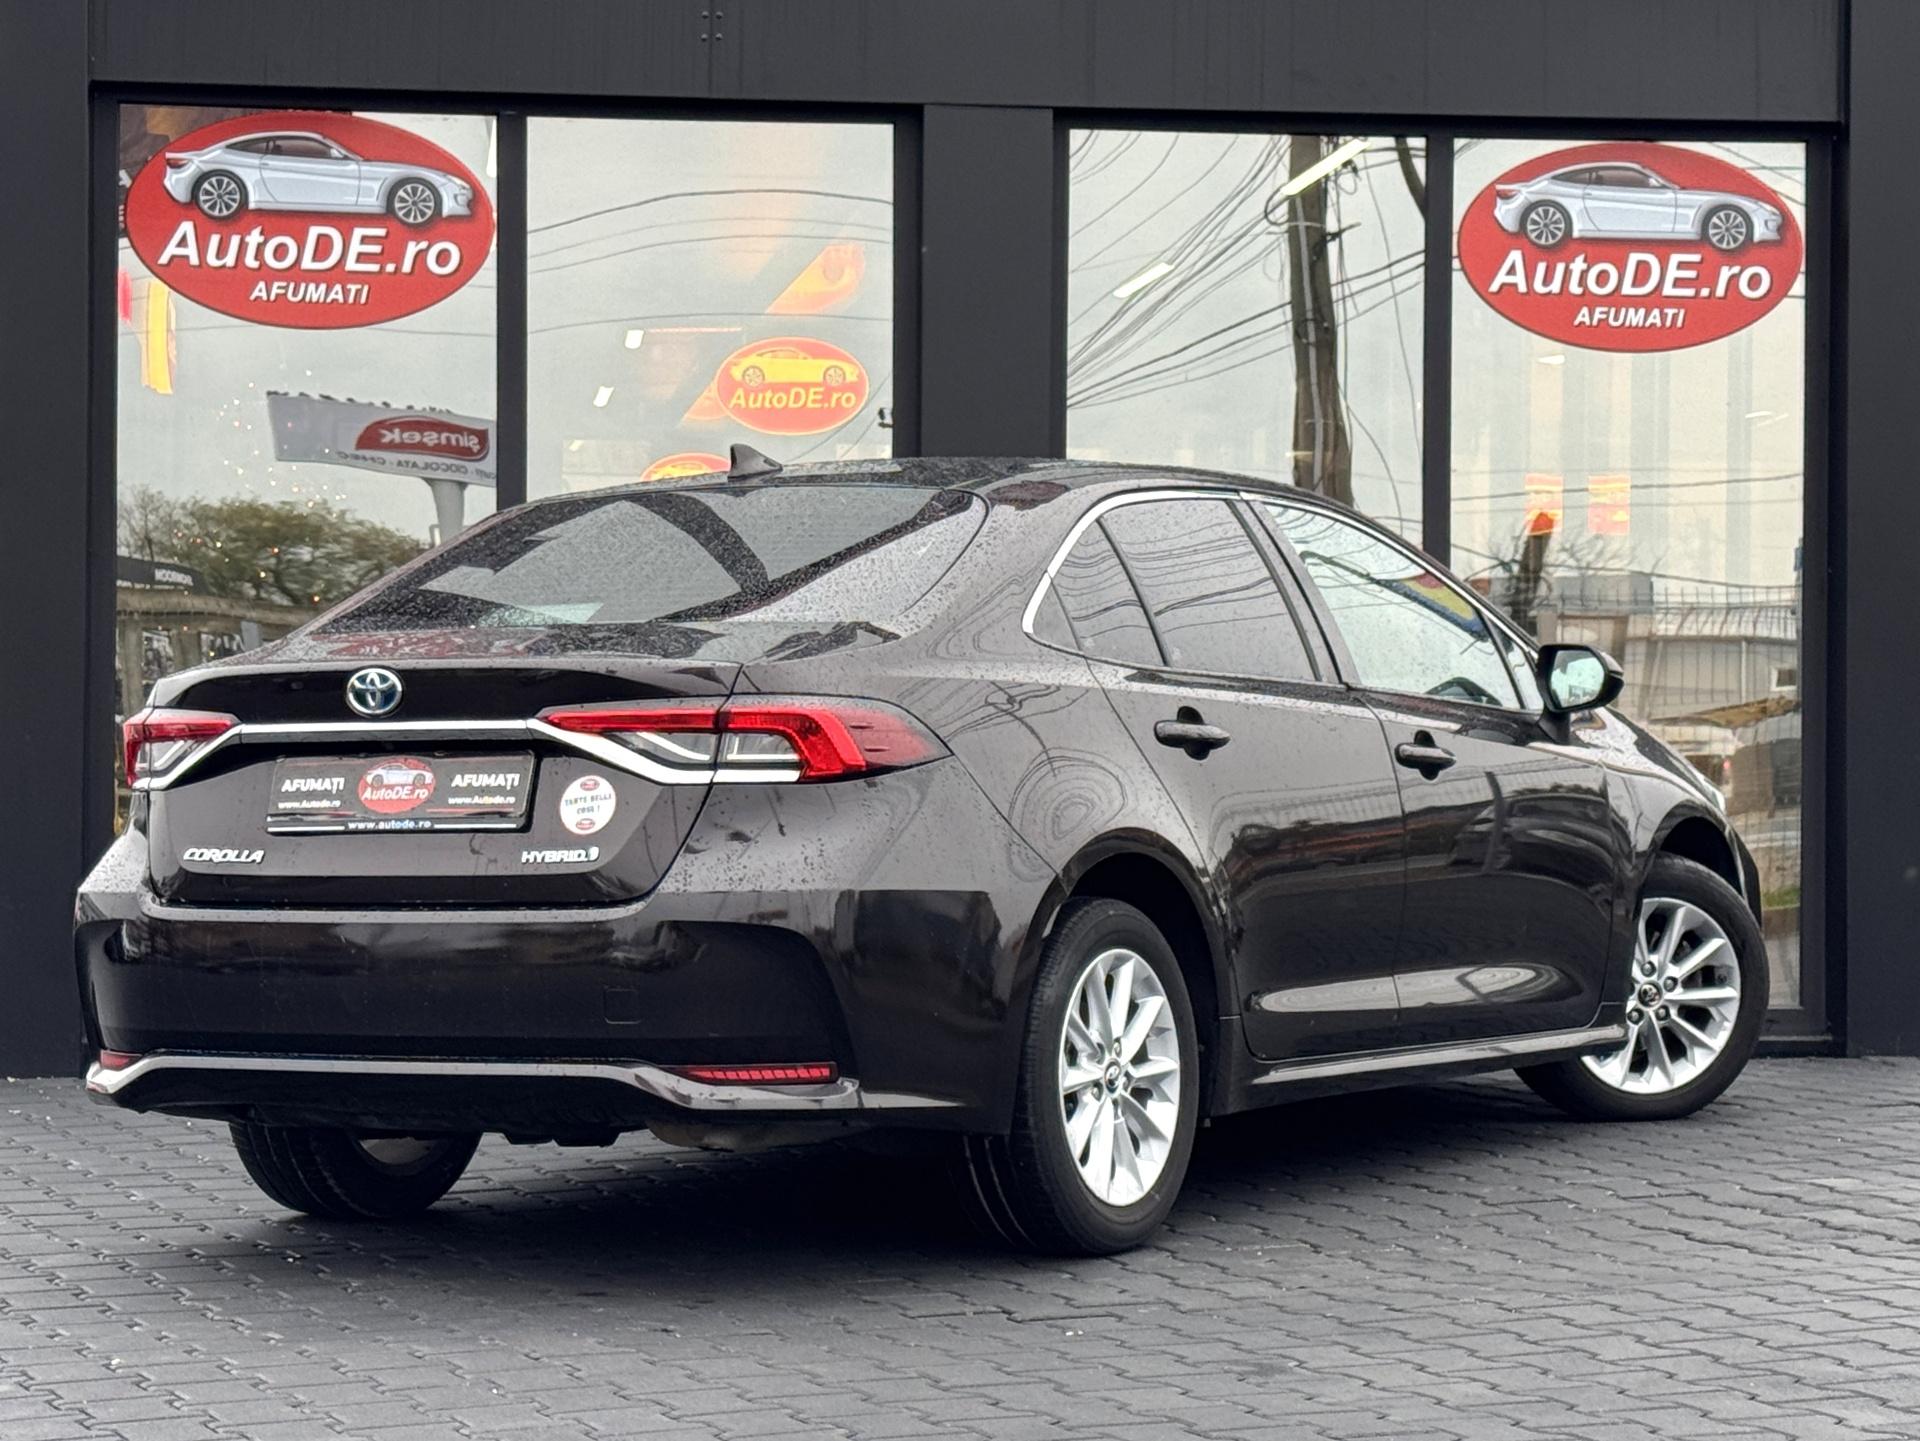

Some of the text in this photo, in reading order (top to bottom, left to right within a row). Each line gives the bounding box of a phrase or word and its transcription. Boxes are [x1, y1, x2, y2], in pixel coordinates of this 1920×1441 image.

[157, 220, 461, 275] AutoDE.ro
[1488, 249, 1772, 300] AutoDE.ro
[249, 280, 369, 305] AFUMATI
[1573, 305, 1686, 329] AFUMATI
[728, 386, 857, 410] AutoDE.ro
[361, 785, 429, 801] AutoDE.ro
[348, 819, 432, 830] www.autode.ro
[183, 847, 265, 864] COROLLA
[521, 849, 588, 864] HYBRID
